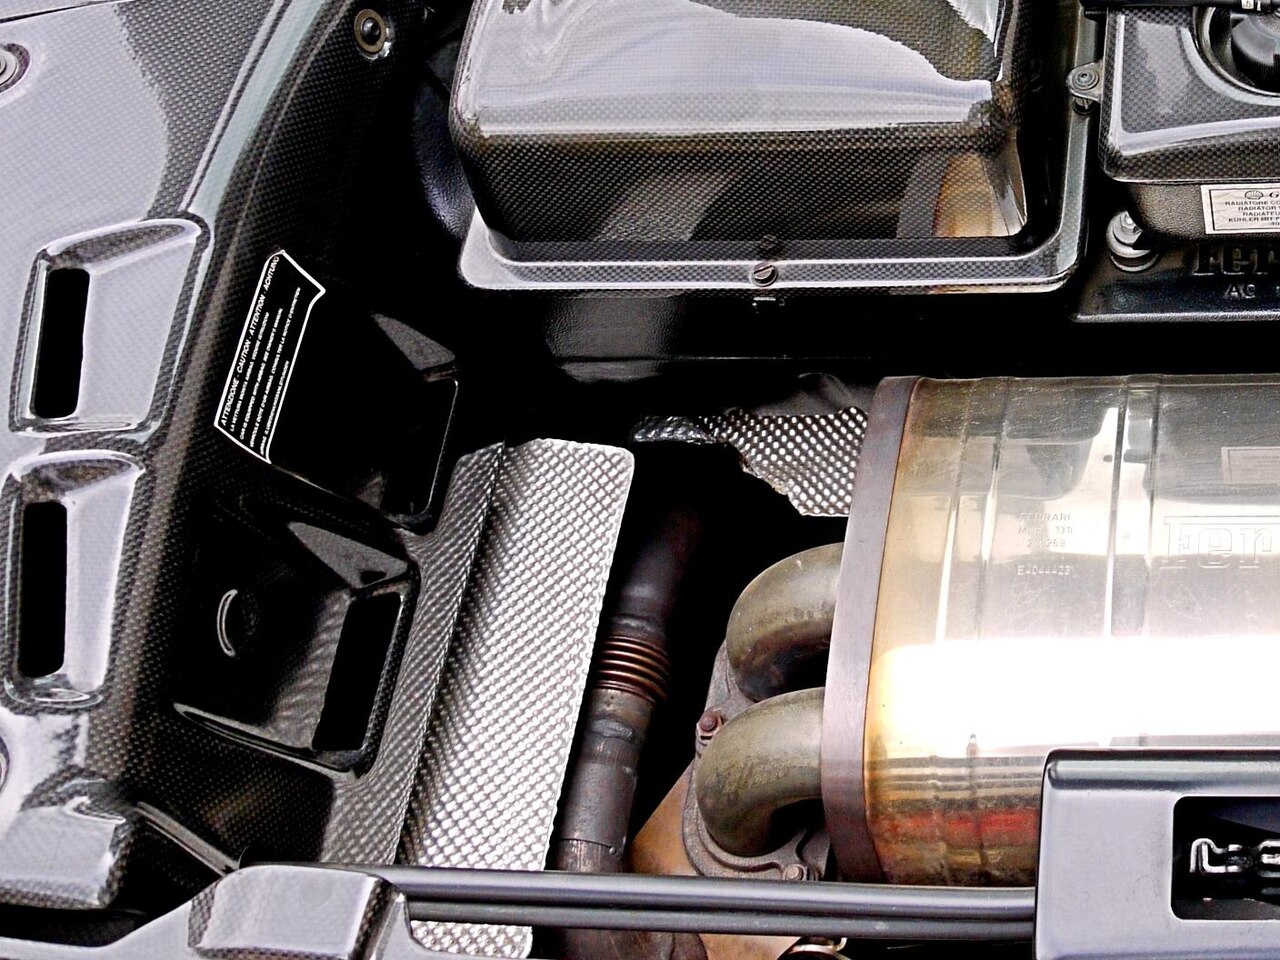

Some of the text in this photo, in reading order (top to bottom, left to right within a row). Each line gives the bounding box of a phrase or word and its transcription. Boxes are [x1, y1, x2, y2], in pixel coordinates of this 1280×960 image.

[220, 377, 239, 426] ATTENZIONE
[236, 339, 251, 373] CAUTION
[248, 293, 265, 335] ATTENTION
[263, 255, 280, 291] ACHTUNG
